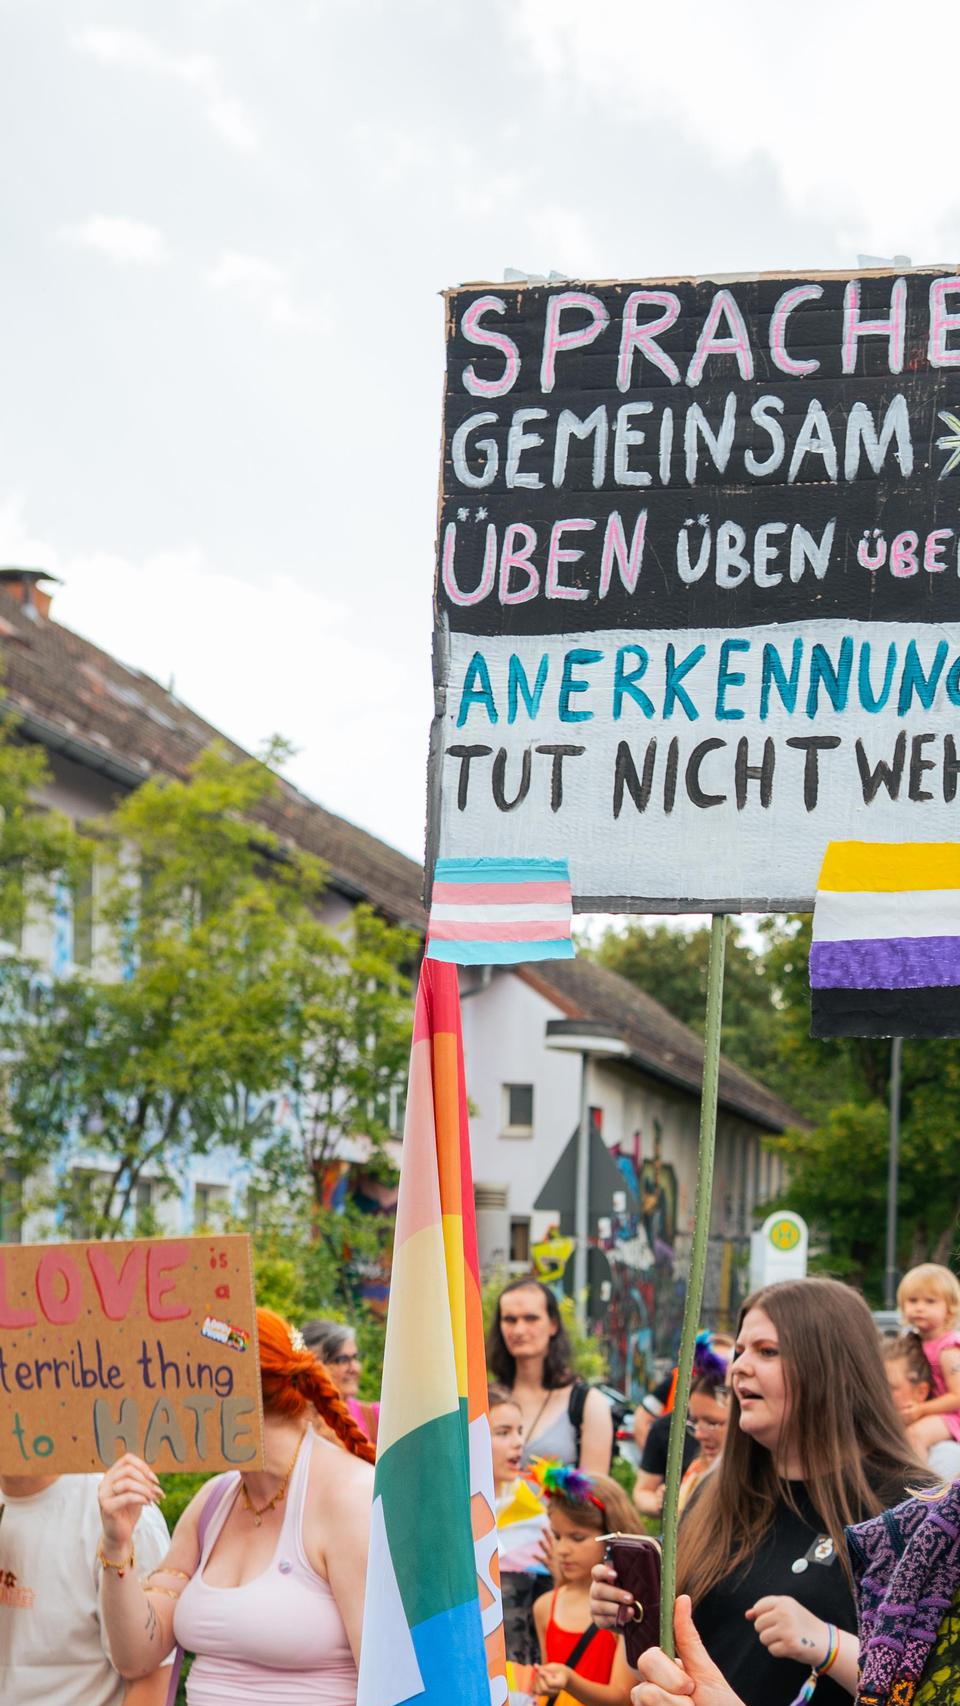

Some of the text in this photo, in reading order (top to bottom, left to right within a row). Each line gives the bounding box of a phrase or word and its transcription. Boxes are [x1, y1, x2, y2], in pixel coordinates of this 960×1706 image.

[451, 391, 914, 489] GEMEINSAM
[443, 506, 647, 605] ÜBEN
[677, 513, 836, 589] ÜBEN
[446, 743, 586, 813] TUT
[613, 736, 842, 820] NICHT
[0, 1244, 192, 1330] LOVE
[209, 1247, 228, 1269] is
[214, 1284, 231, 1300] a
[0, 1340, 234, 1398] terrible thing
[11, 1396, 258, 1466] to HATE
